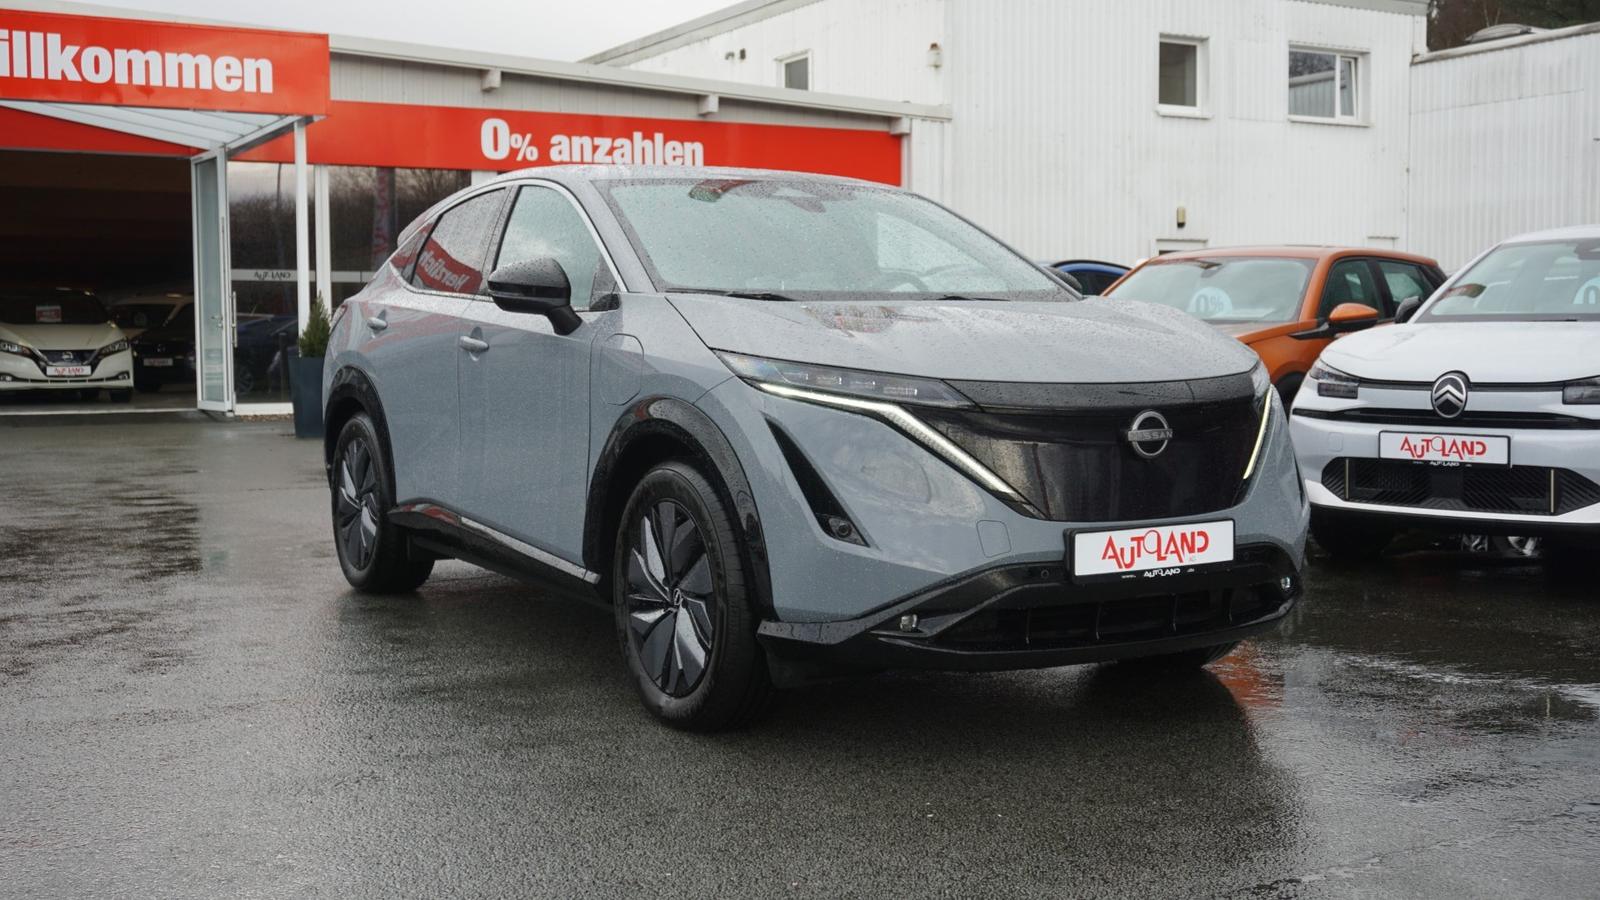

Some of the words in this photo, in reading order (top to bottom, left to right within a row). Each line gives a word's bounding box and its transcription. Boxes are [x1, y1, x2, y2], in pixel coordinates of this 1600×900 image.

[480, 117, 539, 162] 0%
[549, 131, 704, 167] anzahlen
[254, 271, 291, 280] AUTLAND
[1129, 430, 1173, 441] ISSAN
[1400, 435, 1487, 461] AUTOLAND
[1101, 529, 1210, 569] AUTOLAND
